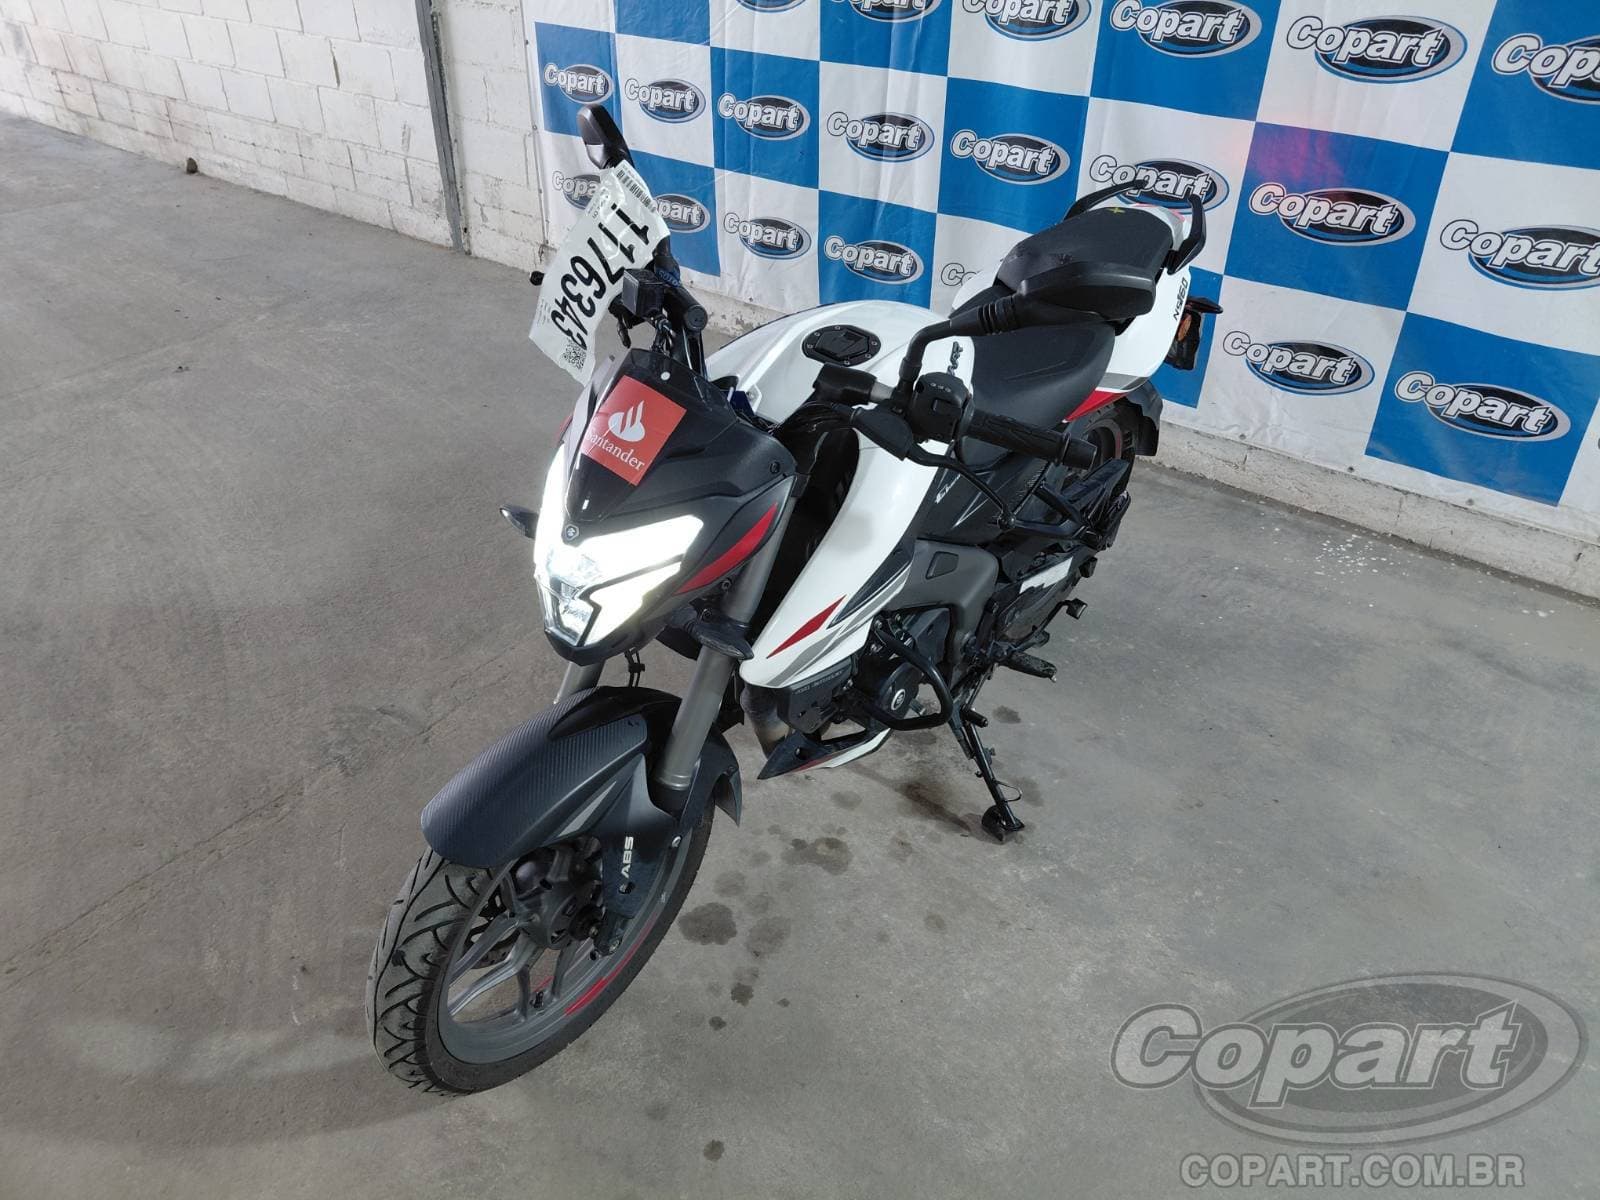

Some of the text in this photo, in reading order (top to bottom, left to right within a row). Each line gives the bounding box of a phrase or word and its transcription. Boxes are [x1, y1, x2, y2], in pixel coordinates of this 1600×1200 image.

[1110, 0, 1244, 43] Copart
[1286, 16, 1446, 66] Copart
[544, 62, 605, 96] Copart
[1492, 33, 1600, 88] Cop
[624, 78, 697, 113] Copart
[718, 93, 801, 130] Copart
[826, 111, 924, 150] Copart
[951, 129, 1056, 175] Copart
[552, 171, 600, 200] Copa
[1090, 155, 1211, 199] Copart
[1249, 182, 1401, 235] Copart
[723, 213, 799, 251] Copart
[551, 203, 650, 351] 1176343
[823, 235, 914, 277] Copart
[1222, 330, 1358, 386] Copart
[1395, 371, 1552, 435] Copart
[586, 427, 645, 471] Santander
[619, 836, 634, 880] ABS
